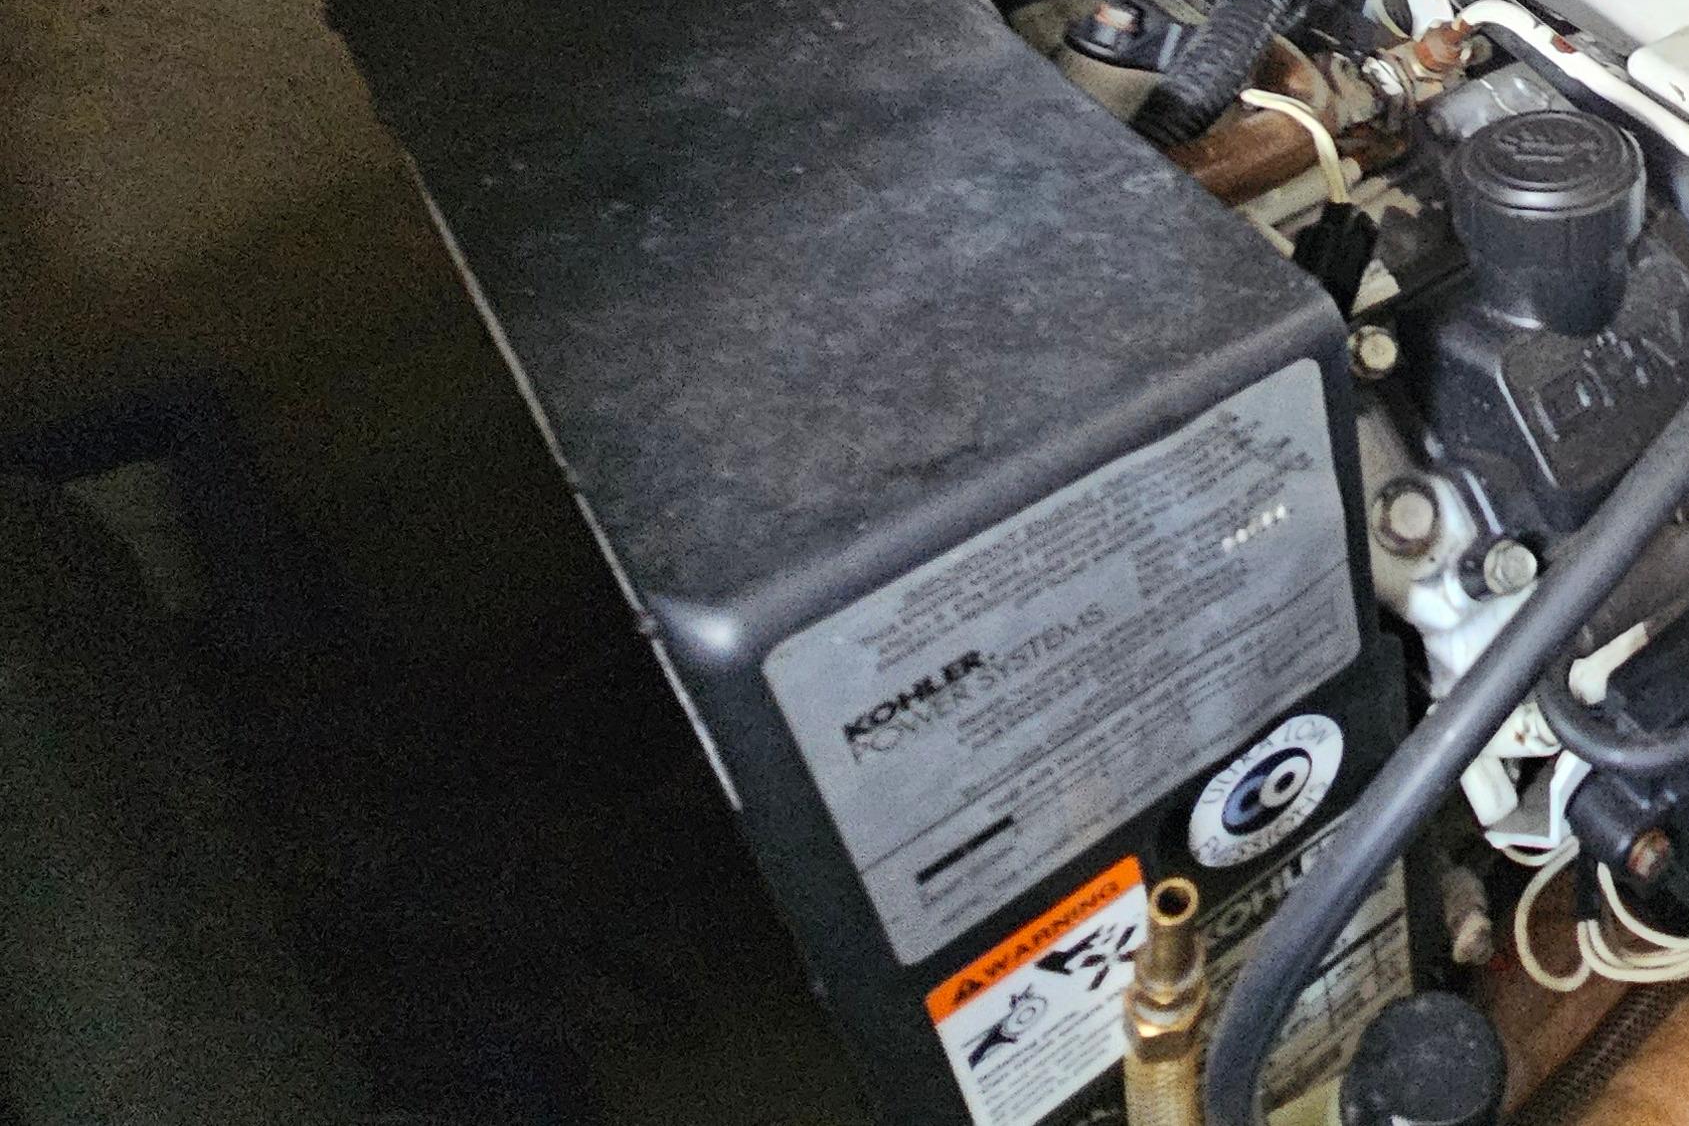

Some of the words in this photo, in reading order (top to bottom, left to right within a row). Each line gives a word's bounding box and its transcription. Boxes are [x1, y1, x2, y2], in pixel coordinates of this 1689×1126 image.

[844, 650, 985, 743] KOHLER
[850, 680, 973, 765] POWER
[976, 602, 1106, 692] SYSTEMS
[983, 880, 1120, 979] WARNING
